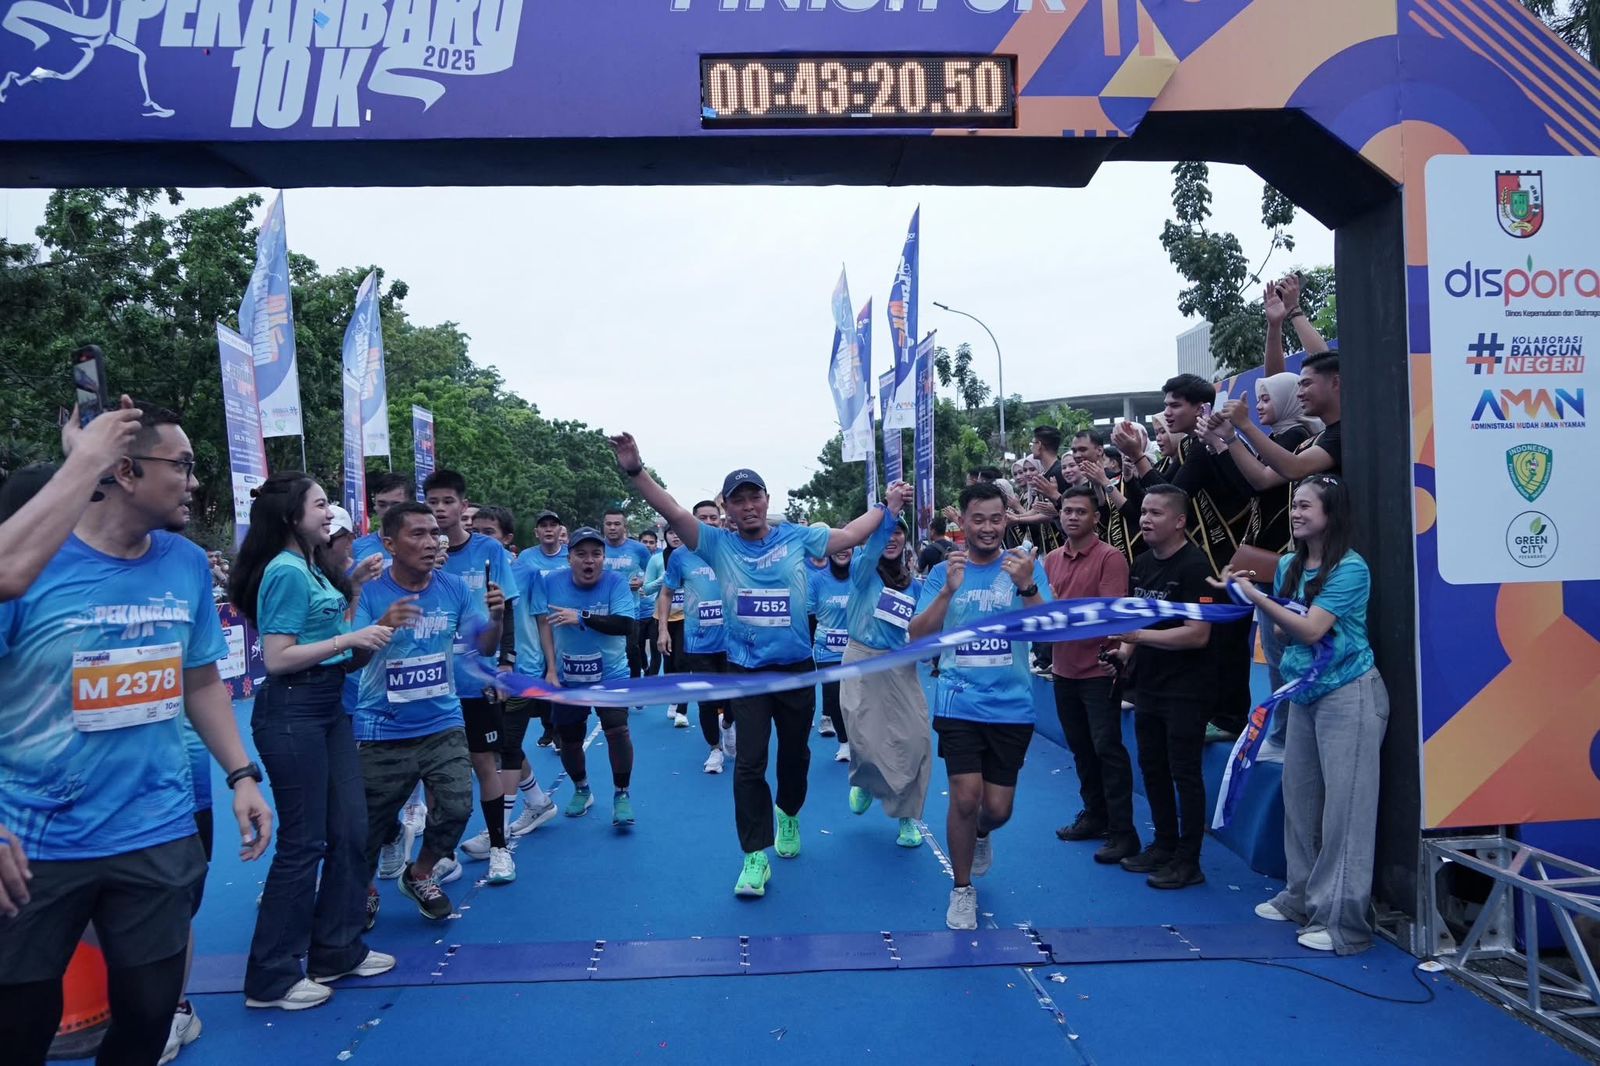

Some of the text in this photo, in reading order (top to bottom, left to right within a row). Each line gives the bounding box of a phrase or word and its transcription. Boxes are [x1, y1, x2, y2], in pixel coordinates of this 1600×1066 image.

[424, 45, 476, 71] 2025
[710, 61, 1003, 115] 00:43:20.50
[1445, 260, 1600, 307] dispora
[1512, 336, 1583, 344] KOLABORASI
[1510, 345, 1582, 357] BANGUN
[1508, 357, 1584, 373] NEGERI
[1471, 388, 1586, 421] AMAN
[1508, 444, 1549, 456] INDONESIA
[1515, 536, 1548, 545] GREEN
[1520, 545, 1544, 554] CITY
[753, 601, 787, 612] 7552
[972, 638, 1008, 650] 5205
[563, 662, 598, 672] M 7123
[389, 667, 442, 686] M 7037
[79, 668, 176, 700] M 2378
